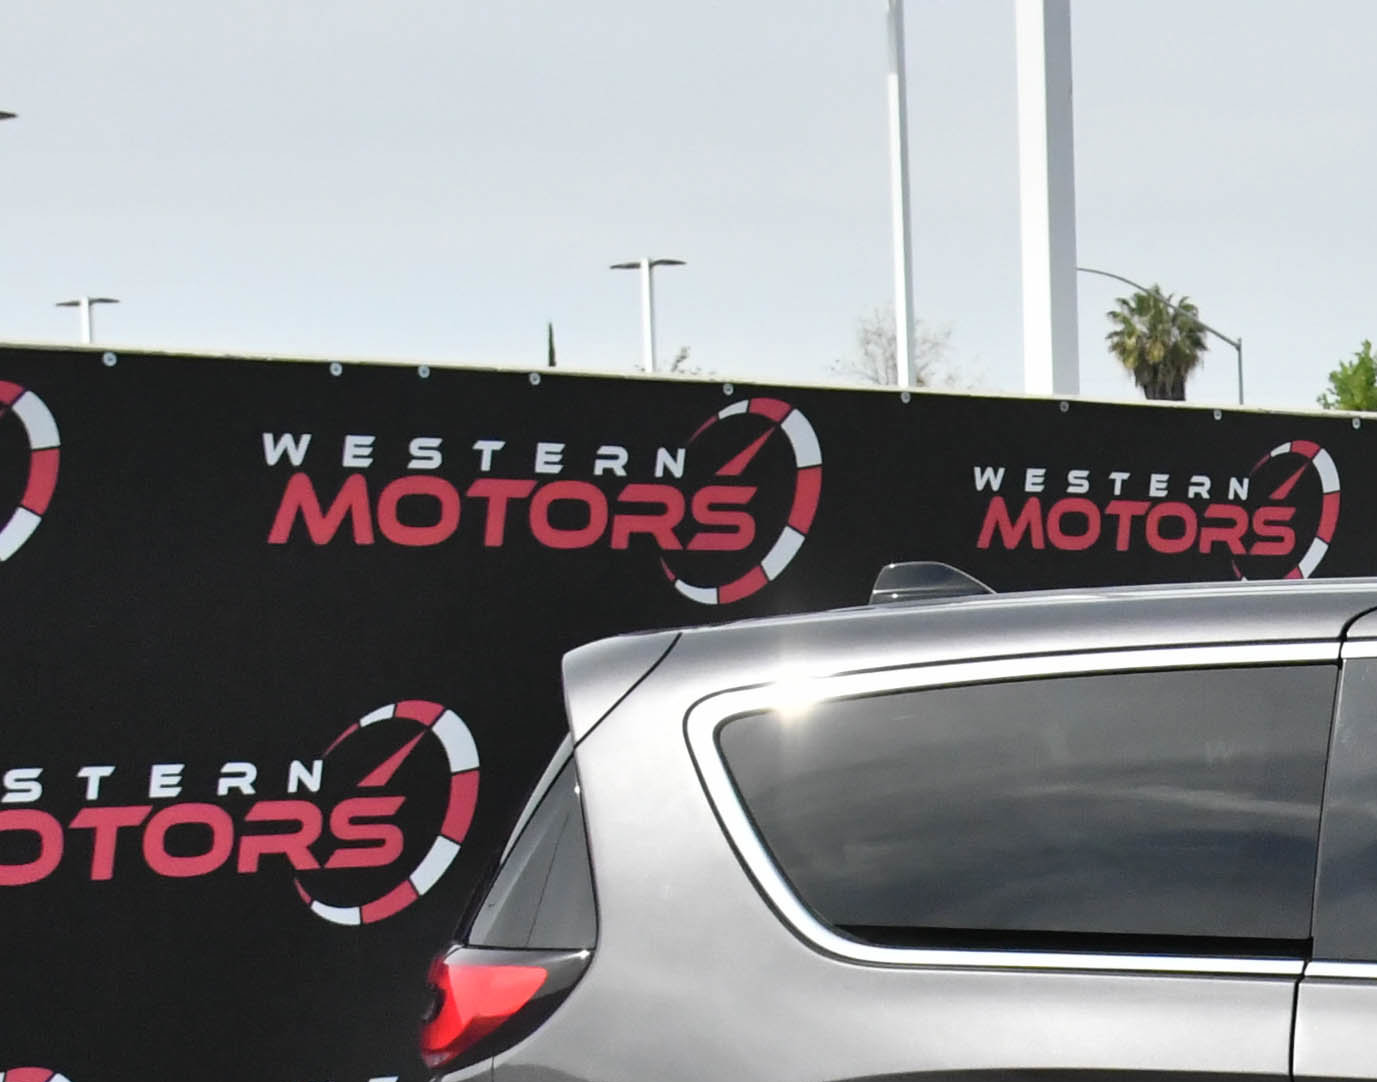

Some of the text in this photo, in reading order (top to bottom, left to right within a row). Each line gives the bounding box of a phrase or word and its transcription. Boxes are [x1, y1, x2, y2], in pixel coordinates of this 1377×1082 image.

[262, 432, 686, 479] WESTERN
[973, 466, 1250, 501] WESTERN
[267, 471, 757, 551] MOTORS
[977, 495, 1296, 556] MOTORS
[0, 759, 323, 804] STERN
